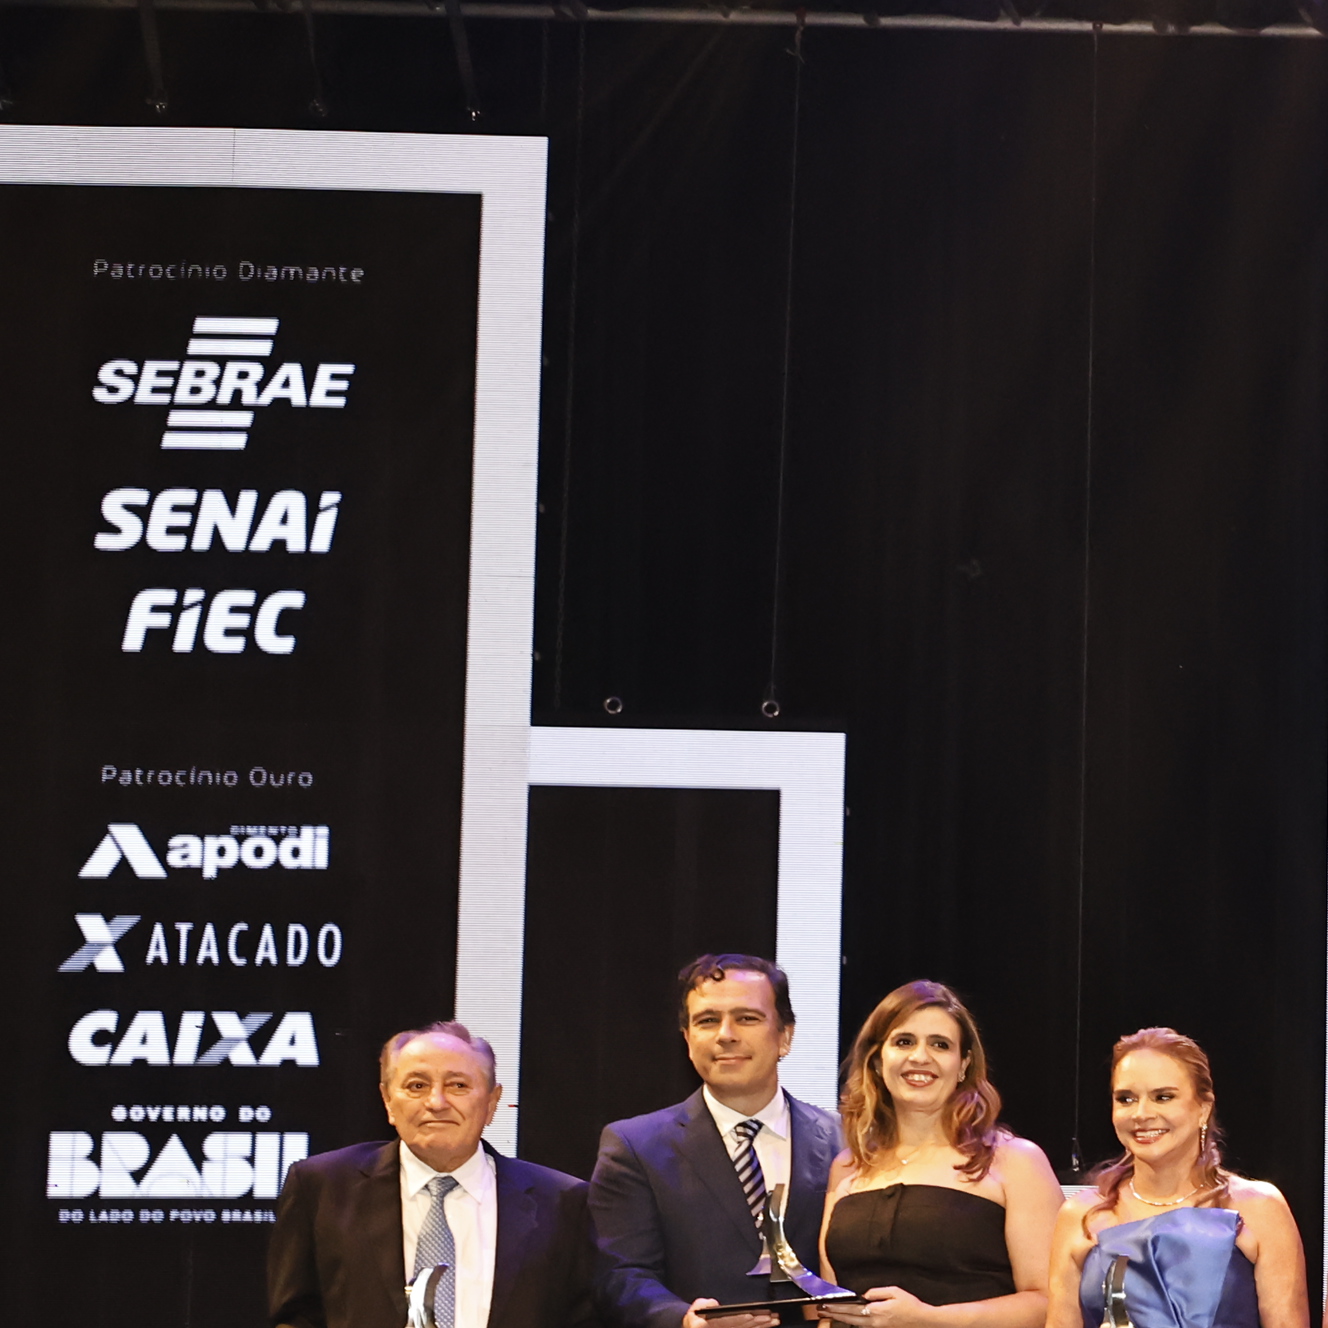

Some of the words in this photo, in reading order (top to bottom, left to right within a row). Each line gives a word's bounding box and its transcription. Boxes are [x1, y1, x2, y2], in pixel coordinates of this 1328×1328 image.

[93, 259, 228, 281] Patrocínio
[238, 260, 365, 283] Diamante
[92, 358, 356, 409] SEBRAE
[101, 765, 238, 787] Patrocínio
[249, 766, 313, 787] Ouro
[166, 825, 330, 879] apodi
[145, 921, 343, 968] ATACADO
[68, 1009, 320, 1067] CAIXA
[111, 1104, 227, 1122] GOVERNO
[238, 1105, 273, 1122] DO
[58, 1209, 85, 1223] DO
[89, 1209, 135, 1223] LADO
[139, 1209, 165, 1224] DO
[170, 1209, 217, 1224] POVO
[221, 1209, 277, 1224] BRASIL
